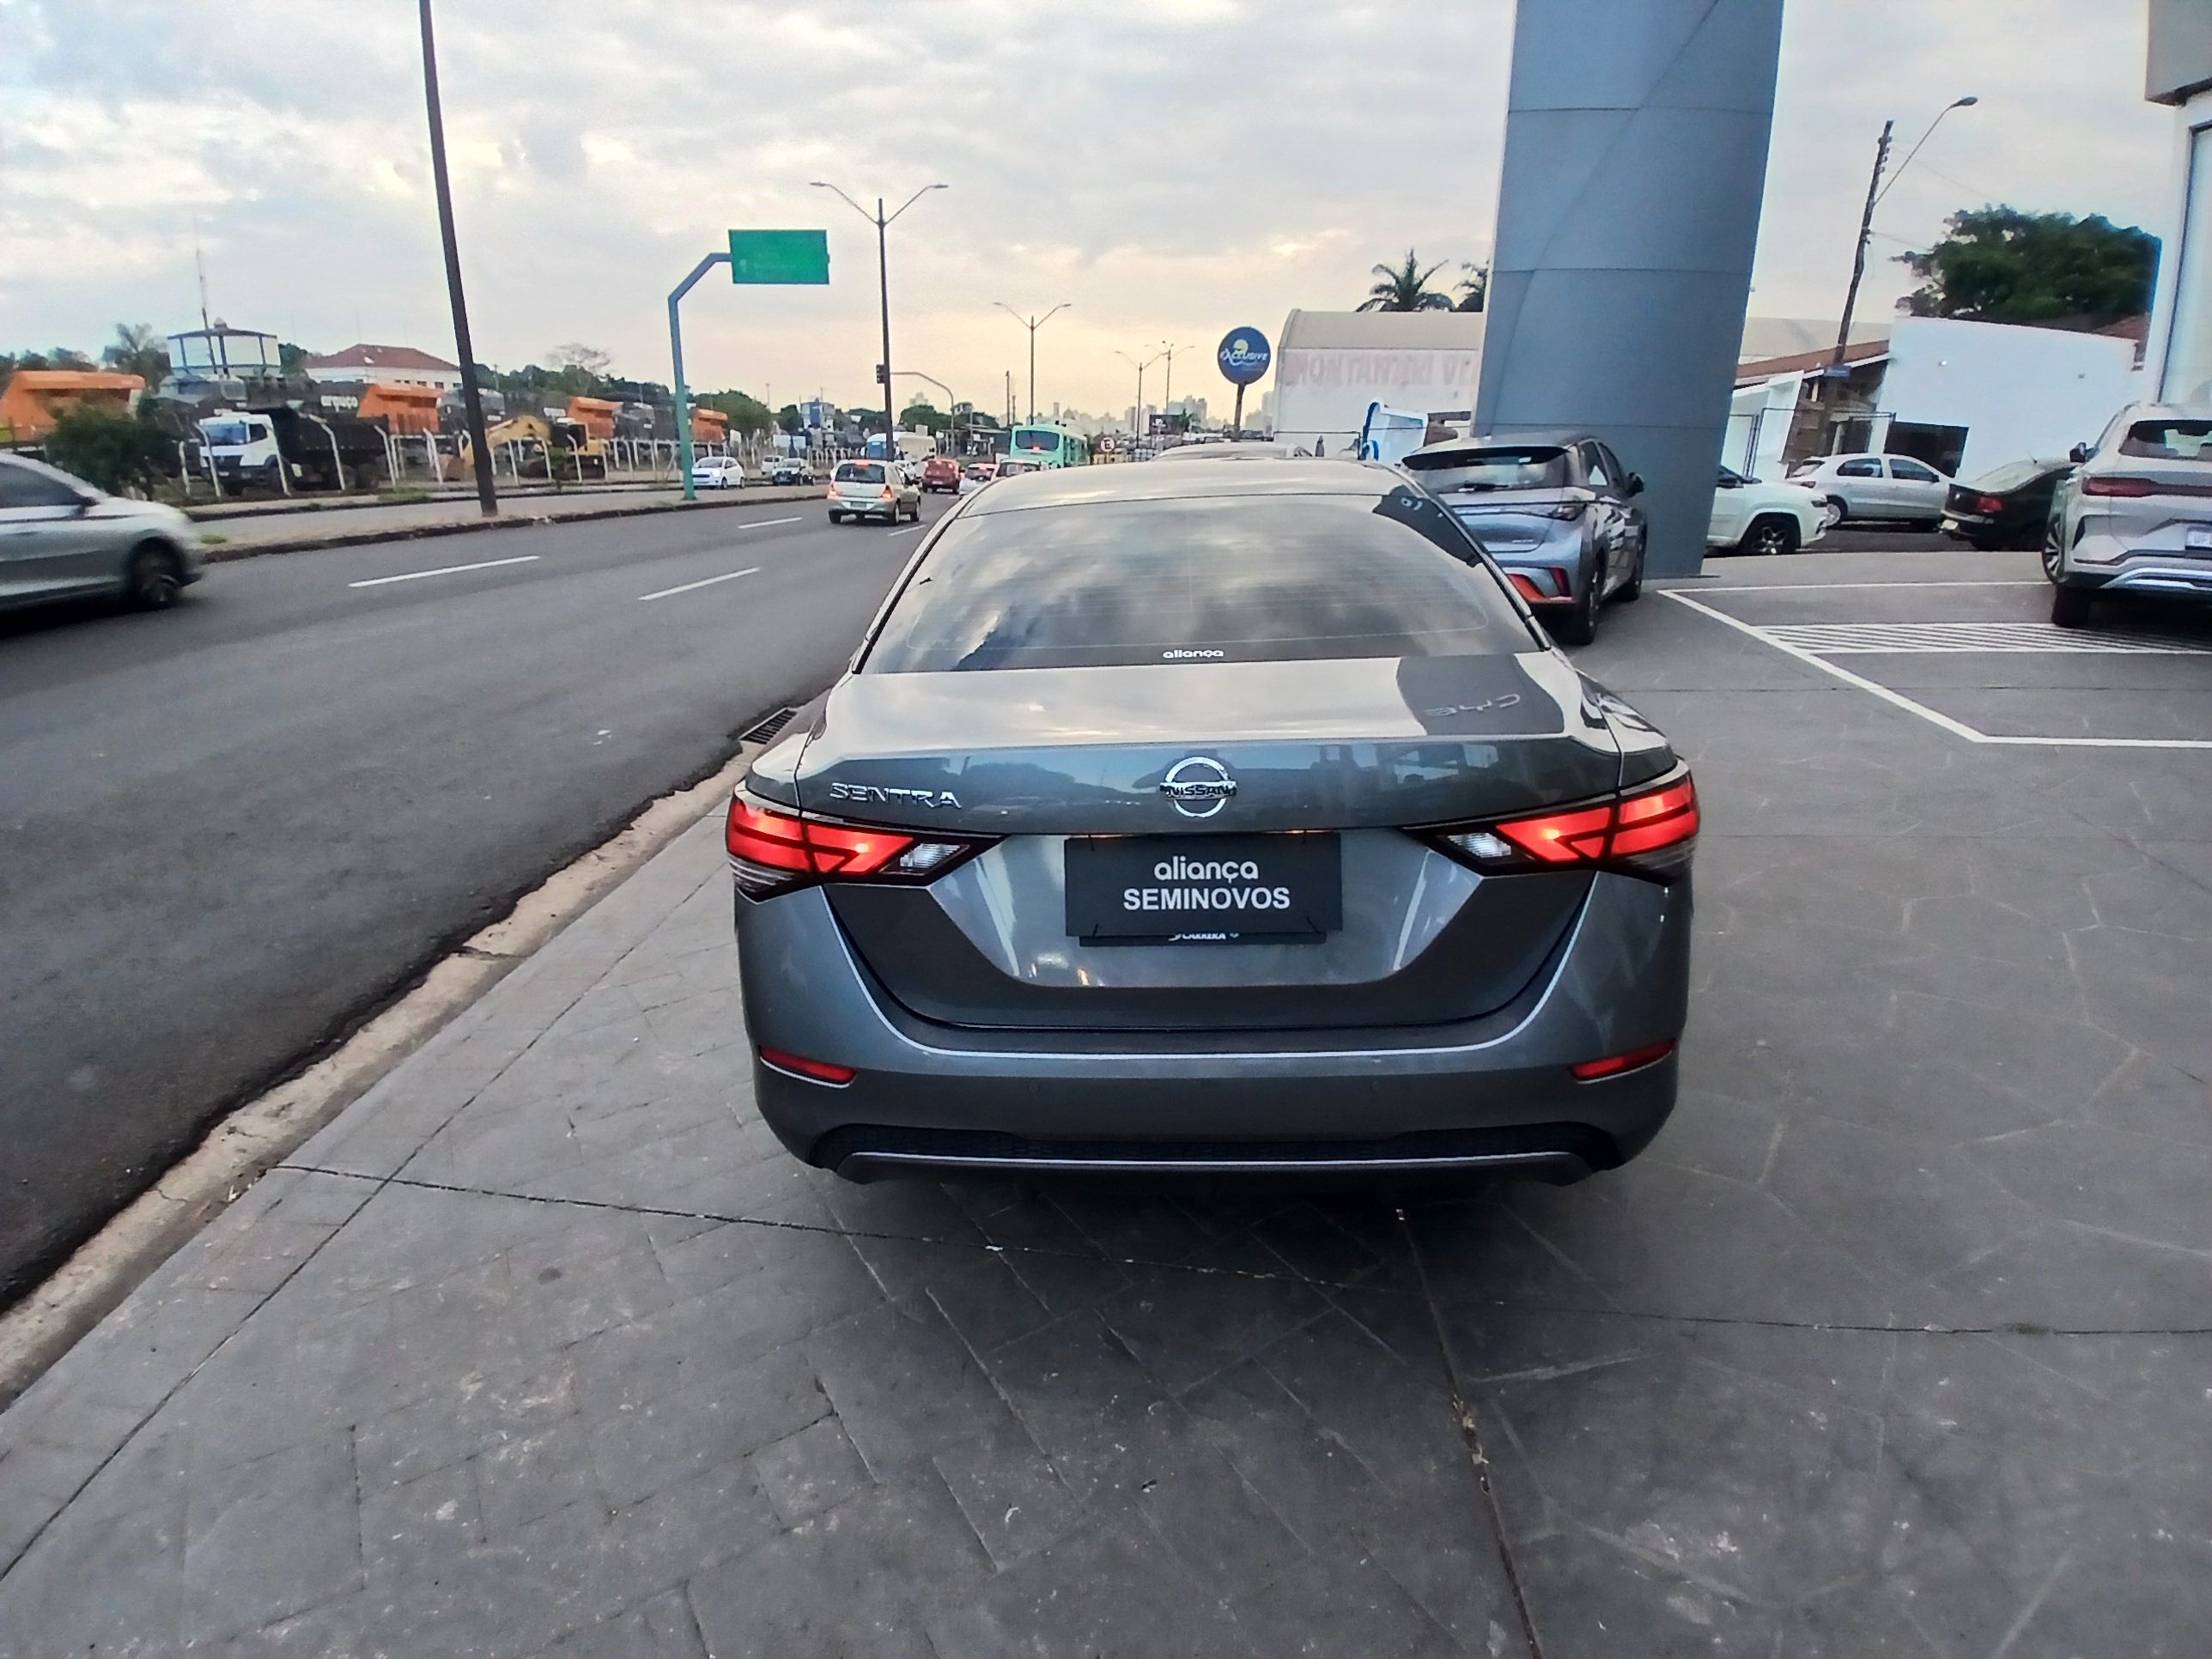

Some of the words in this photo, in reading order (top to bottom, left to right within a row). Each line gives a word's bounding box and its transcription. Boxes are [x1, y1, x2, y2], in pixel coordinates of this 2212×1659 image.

[830, 782, 963, 809] SENTRA
[1168, 784, 1231, 798] NISSAN
[1154, 856, 1259, 884] aliança
[1123, 887, 1291, 910] SEMINOVOS
